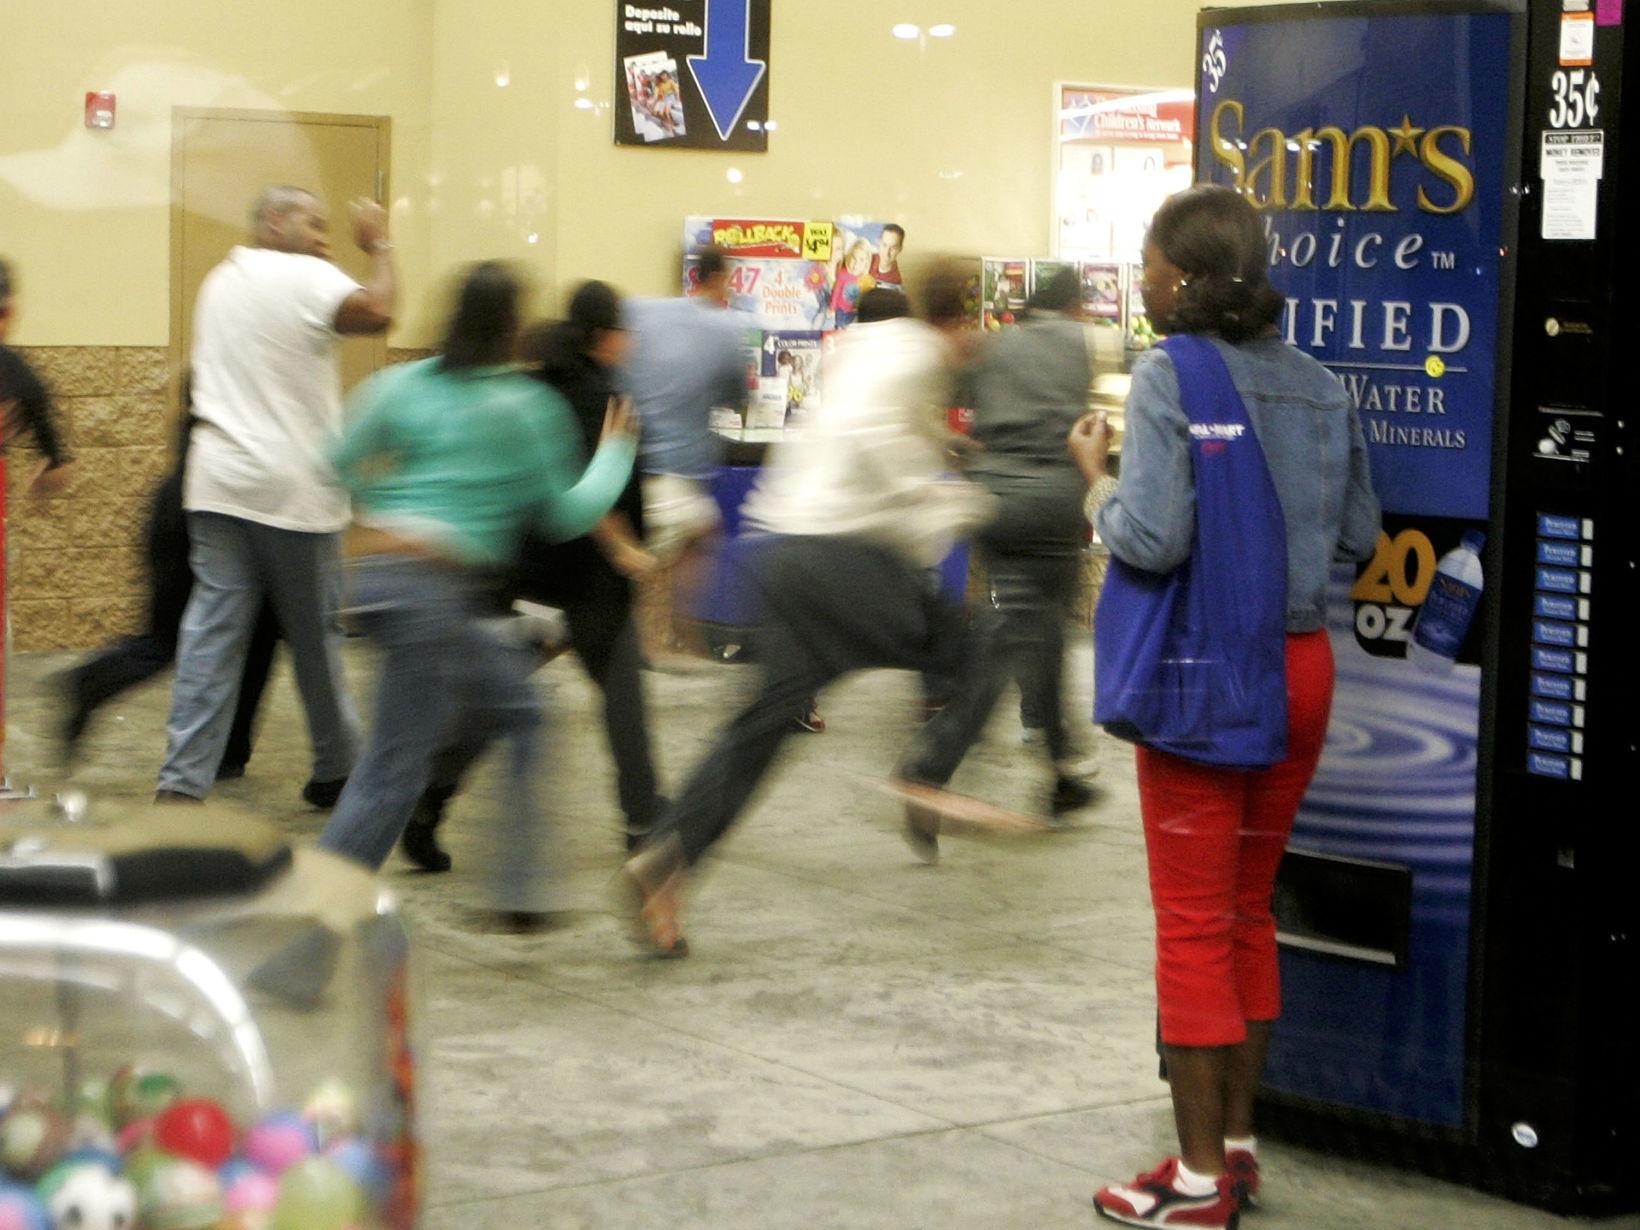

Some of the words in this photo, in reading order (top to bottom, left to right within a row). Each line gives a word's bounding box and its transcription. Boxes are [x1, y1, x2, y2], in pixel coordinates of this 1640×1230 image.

[656, 23, 670, 33] su
[673, 21, 702, 36] rollo
[1264, 216, 1424, 270] hoice
[763, 286, 801, 299] Double
[764, 301, 798, 314] Prints
[1283, 297, 1471, 352] IFIED
[1338, 373, 1446, 414] WATER
[1369, 419, 1466, 448] MINERALS
[1351, 528, 1437, 607] 20
